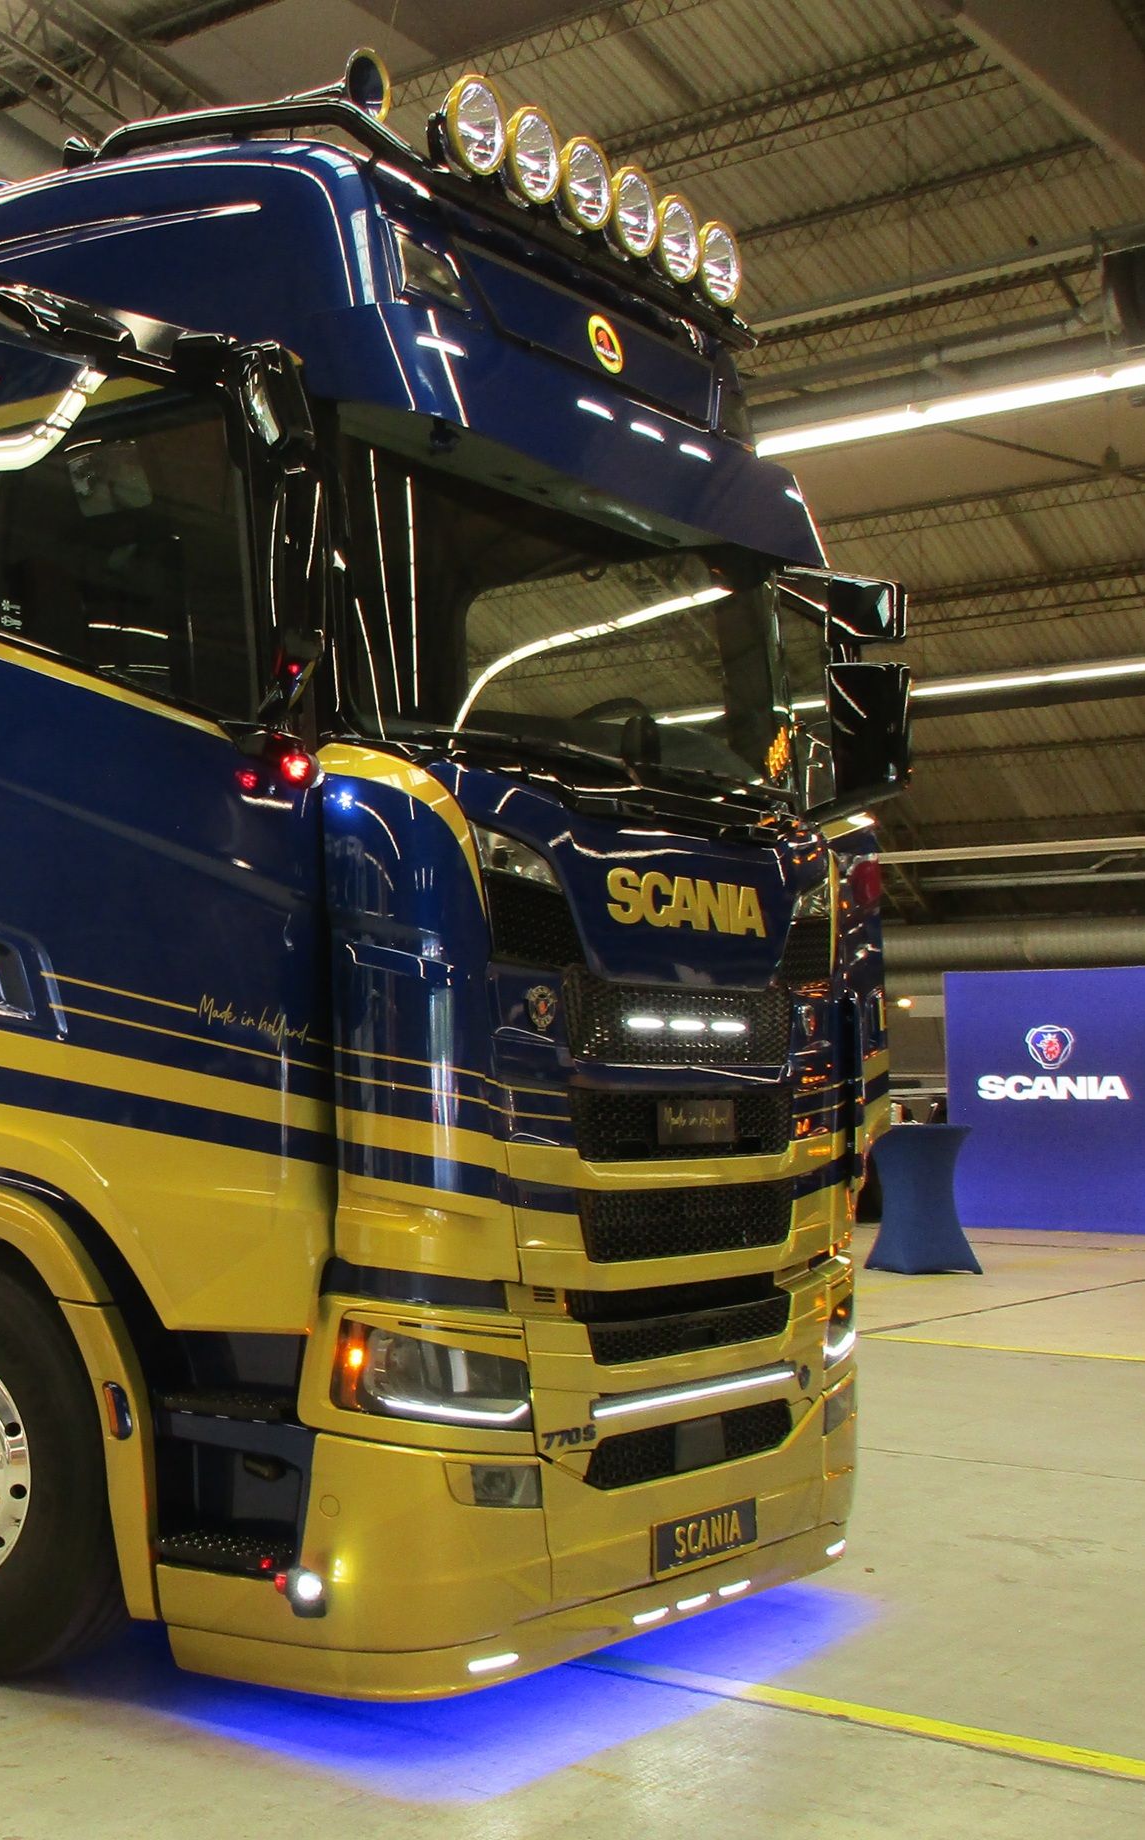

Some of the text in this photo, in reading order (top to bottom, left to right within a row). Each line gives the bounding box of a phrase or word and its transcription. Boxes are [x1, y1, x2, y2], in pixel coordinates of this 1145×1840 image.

[607, 867, 767, 938] SCANIA
[977, 1075, 1130, 1101] SCANIA
[674, 1509, 743, 1559] SCANIA
